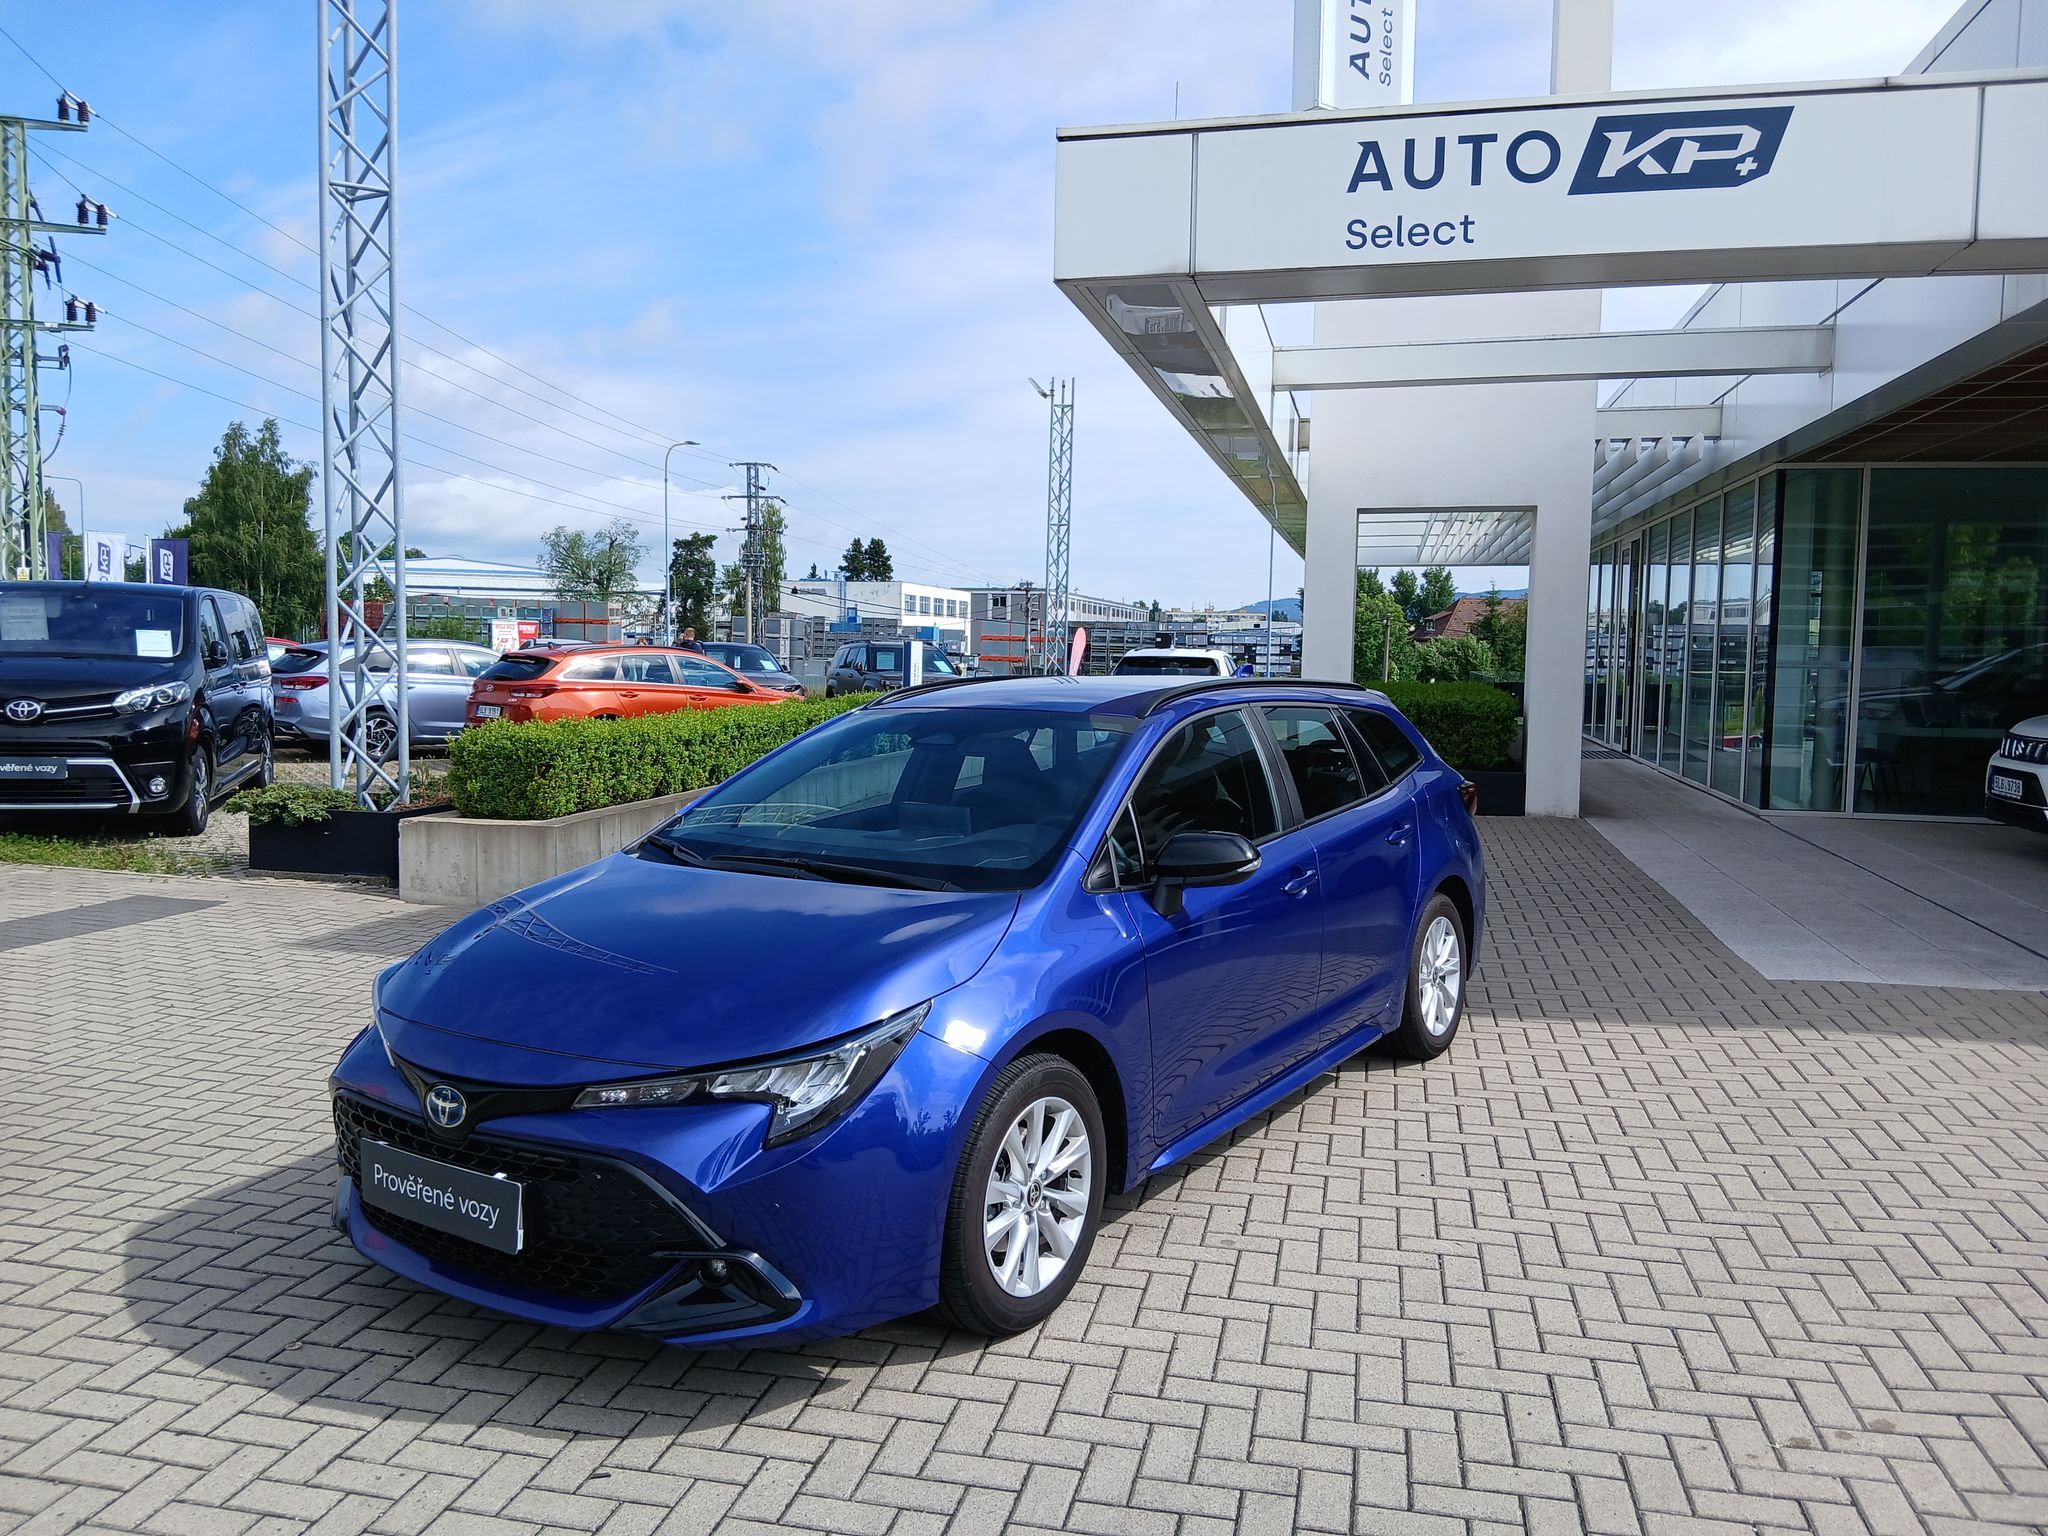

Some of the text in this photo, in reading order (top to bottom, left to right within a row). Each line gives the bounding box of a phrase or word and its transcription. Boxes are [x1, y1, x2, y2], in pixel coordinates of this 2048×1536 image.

[1349, 0, 1372, 80] AU
[1379, 7, 1393, 87] Select
[1346, 129, 1562, 193] AUTO
[1345, 214, 1476, 250] Select
[35, 765, 58, 774] vozy
[373, 1163, 500, 1230] Prověřené vozy
